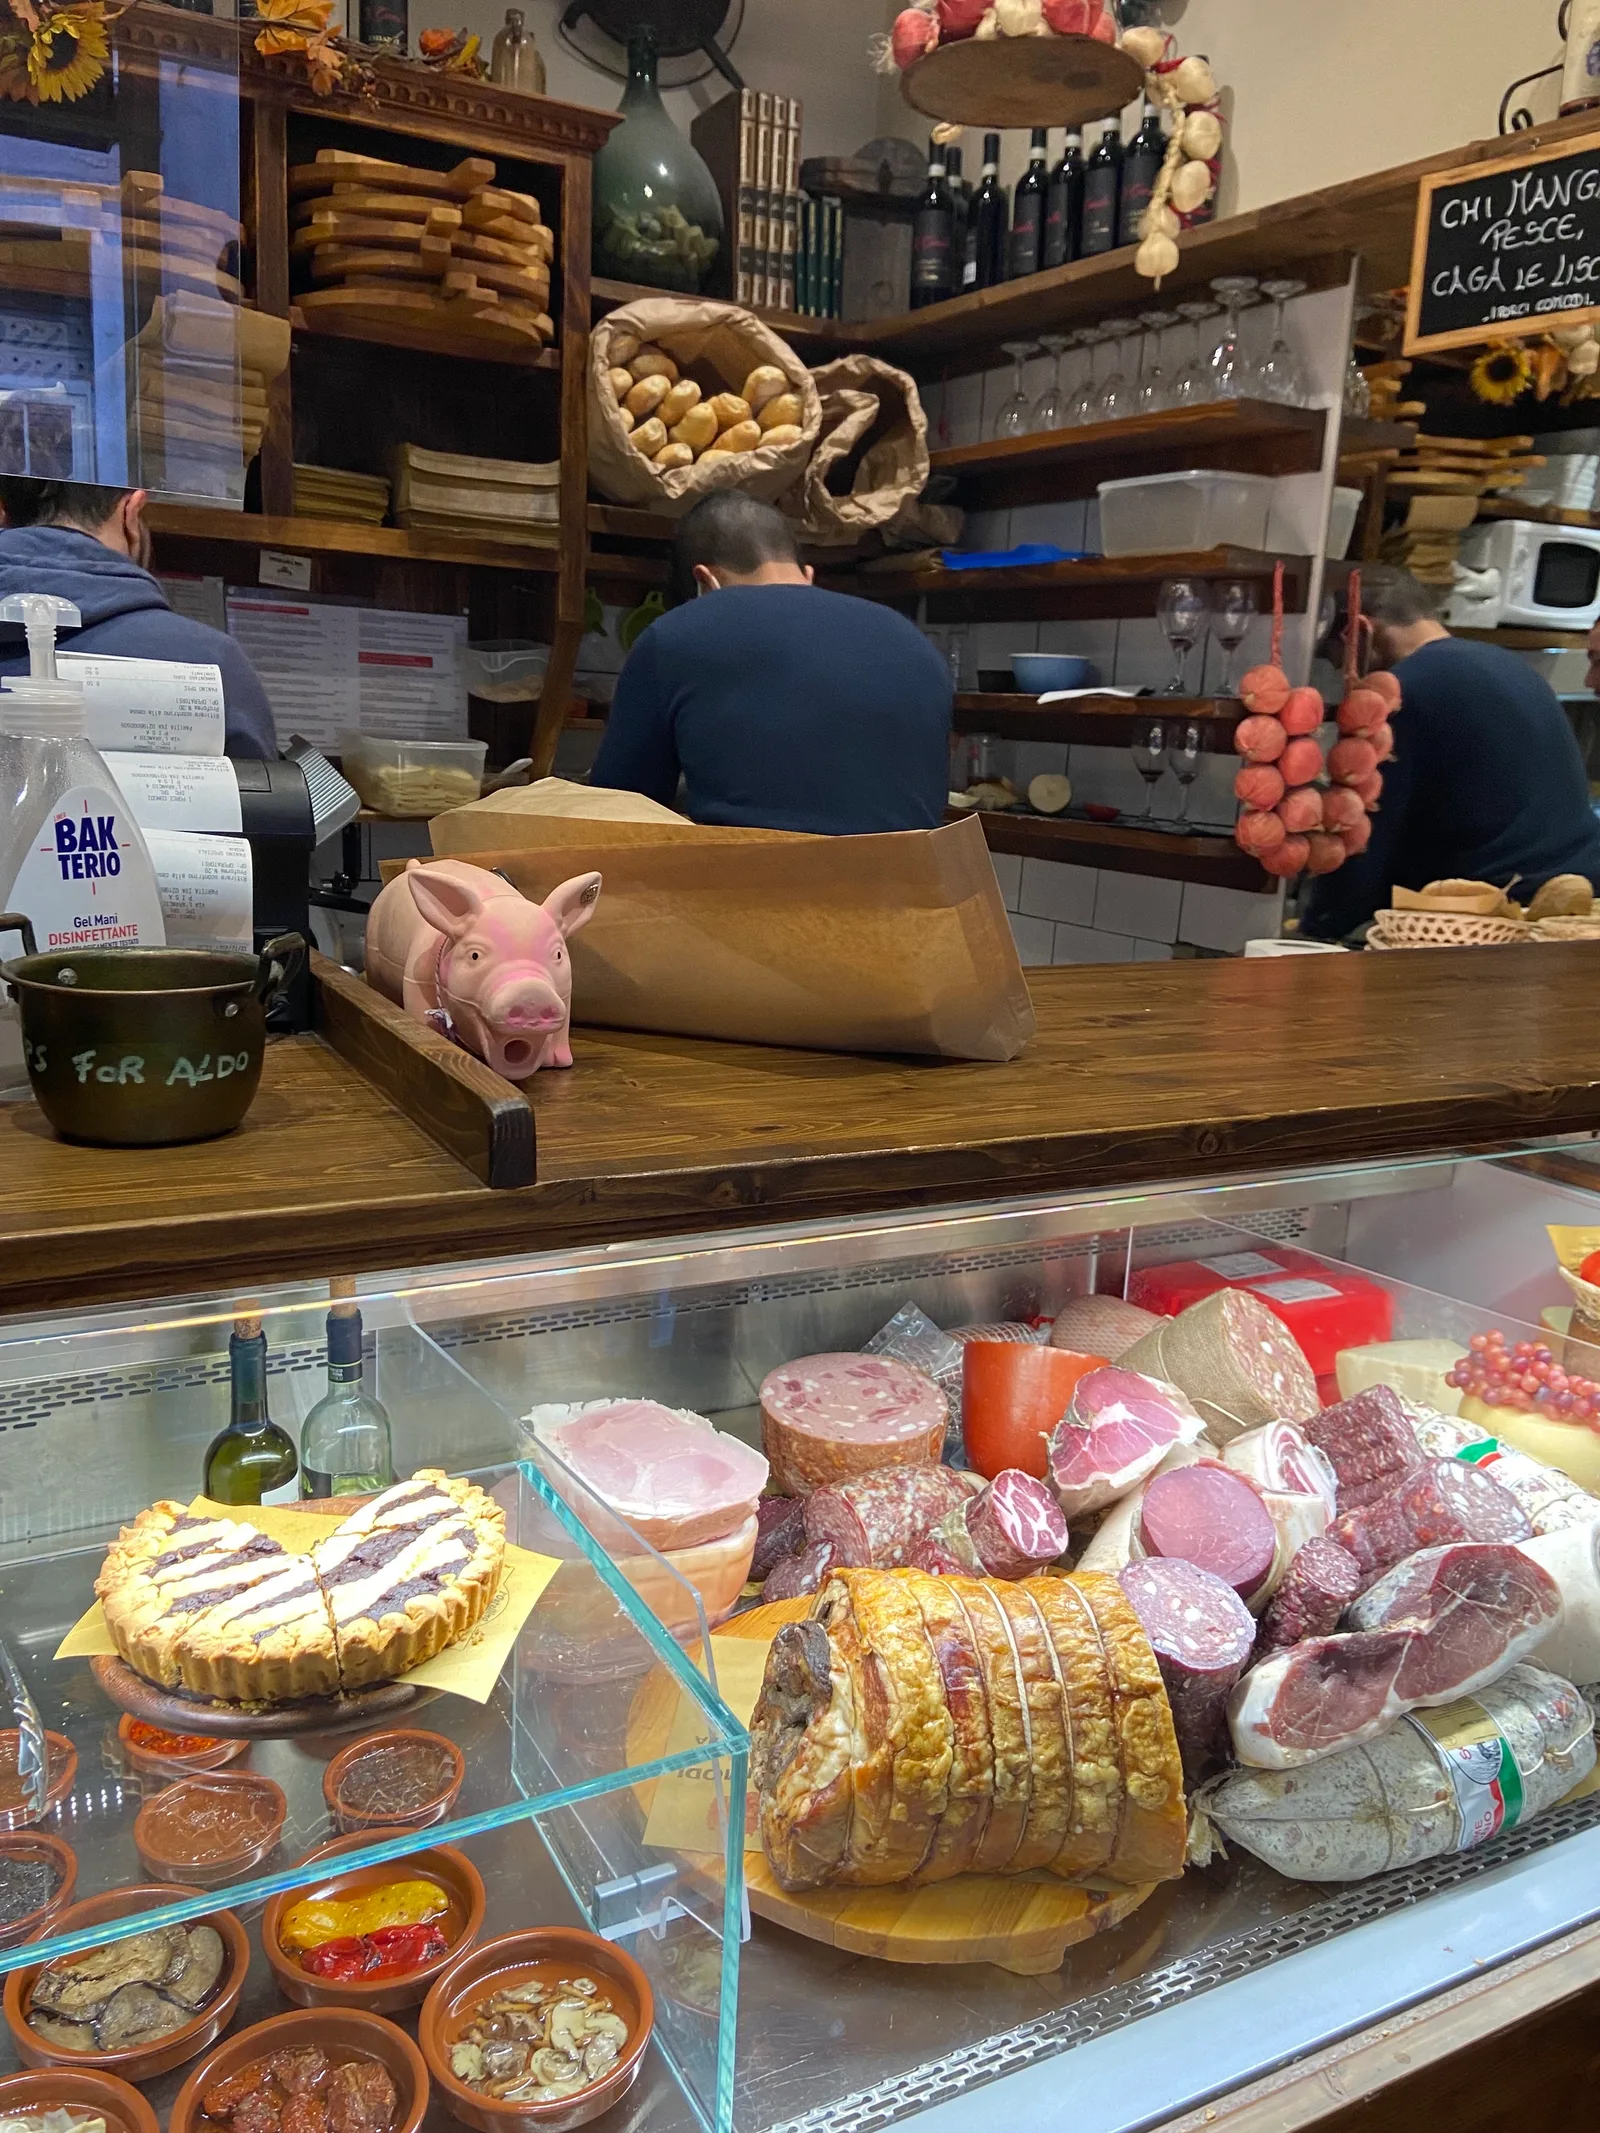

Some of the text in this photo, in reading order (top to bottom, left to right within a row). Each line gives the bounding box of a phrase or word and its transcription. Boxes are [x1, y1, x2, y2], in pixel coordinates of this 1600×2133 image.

[1440, 196, 1492, 229] CHI
[1479, 213, 1584, 252] PESCE,
[1513, 262, 1545, 291] LE
[55, 816, 119, 853] BAK
[57, 851, 121, 880] TERIO
[194, 887, 218, 895] PARTITA
[73, 912, 118, 928] Gel Mani
[48, 924, 138, 946] DISINFETTANTE
[165, 1051, 249, 1087] ALDO
